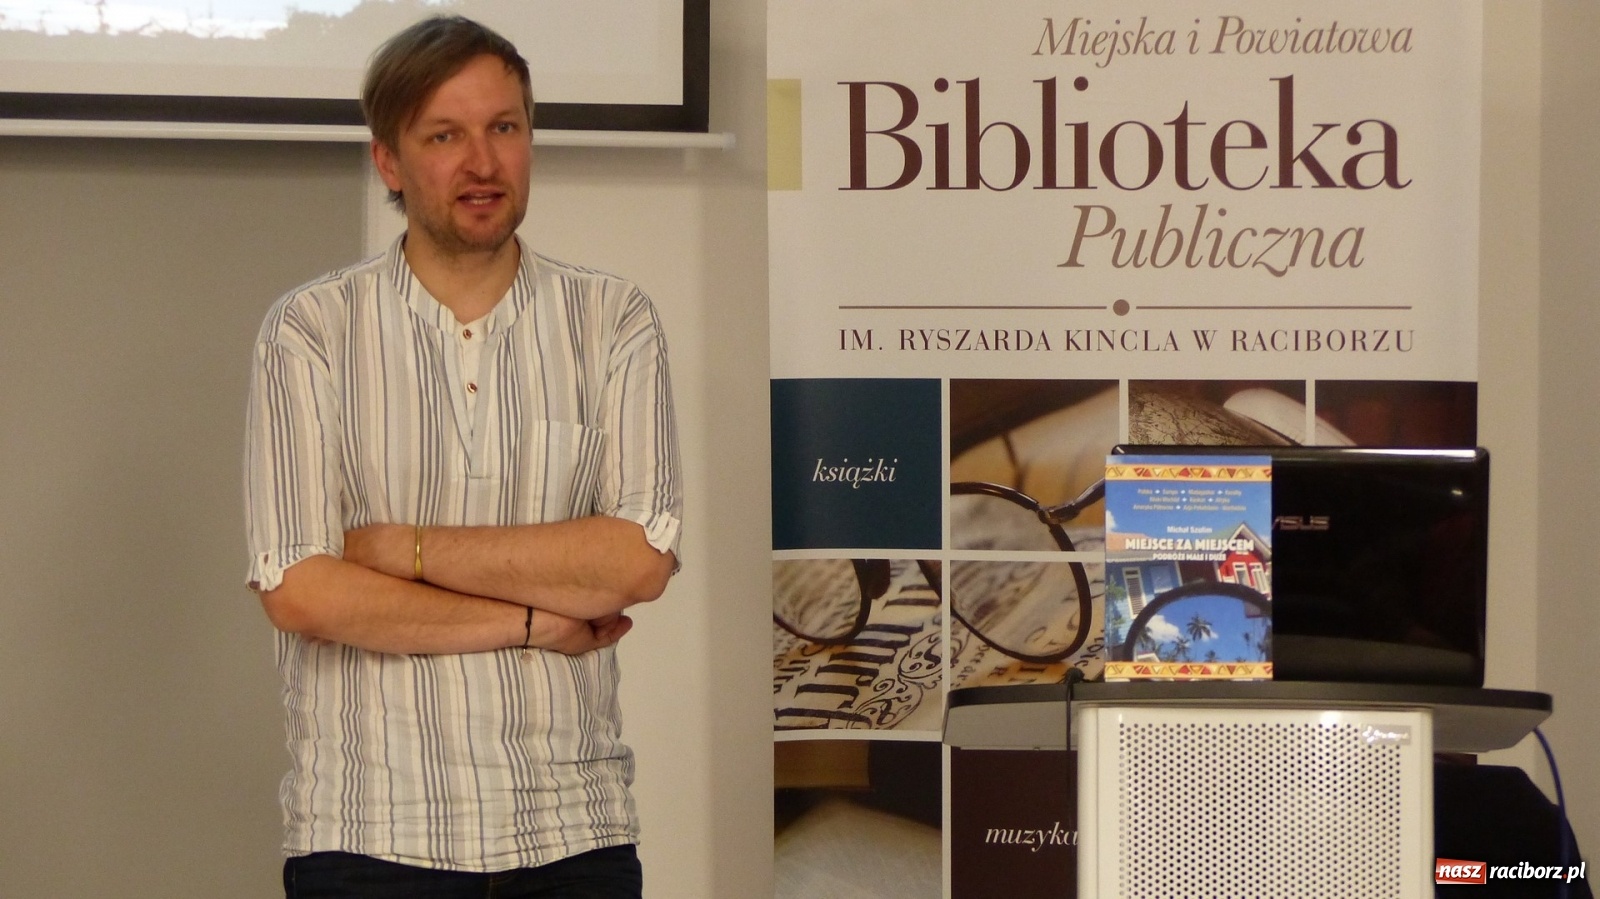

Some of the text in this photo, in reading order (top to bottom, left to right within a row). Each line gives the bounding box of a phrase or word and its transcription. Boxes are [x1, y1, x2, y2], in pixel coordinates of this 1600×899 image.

[1032, 16, 1413, 69] Miejska i Powiatowa
[837, 74, 1413, 192] Biblioteka
[1056, 203, 1366, 278] Publiczna
[838, 328, 1414, 353] IM. RYSZARDA KINCLA W RACIBORZU
[812, 457, 898, 489] książki
[1125, 538, 1255, 551] MIEJSCE ZA MIEJSCEM
[985, 822, 1077, 852] muzyka
